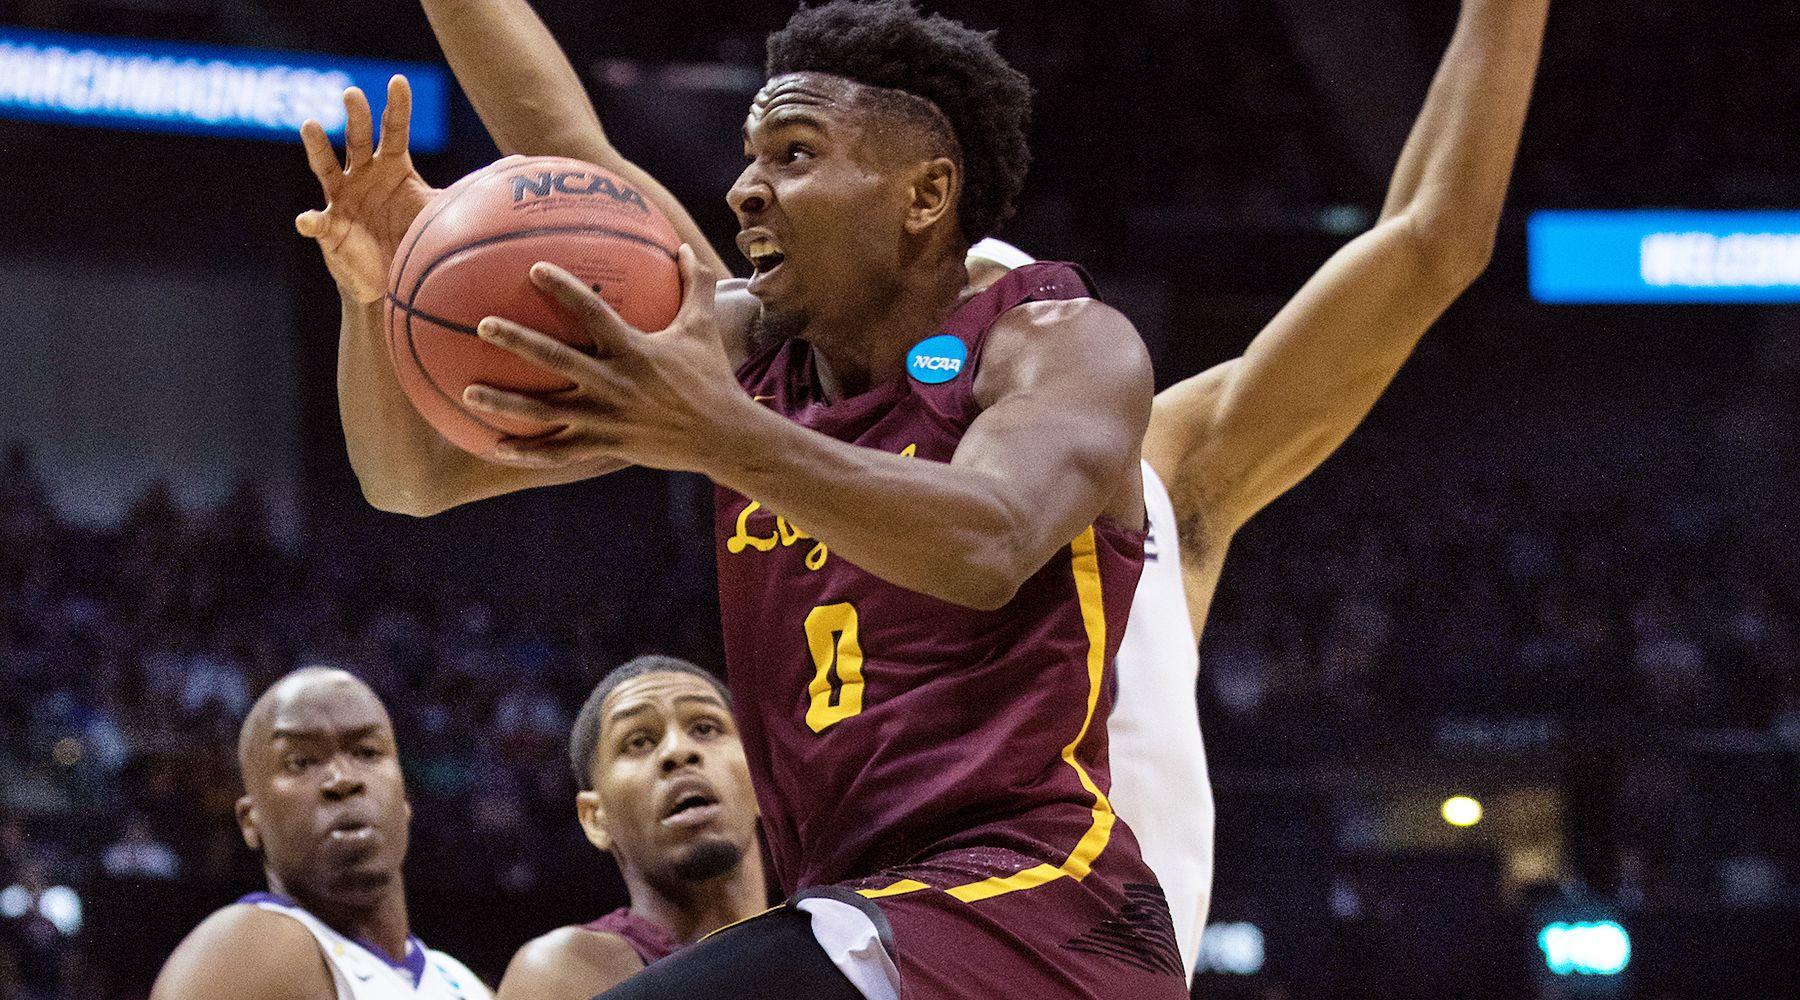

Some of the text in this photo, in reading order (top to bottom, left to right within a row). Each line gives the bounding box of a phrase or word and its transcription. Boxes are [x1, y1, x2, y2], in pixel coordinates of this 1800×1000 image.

[511, 171, 650, 214] NCAA
[913, 354, 961, 373] NCAA
[804, 602, 865, 733] 0
